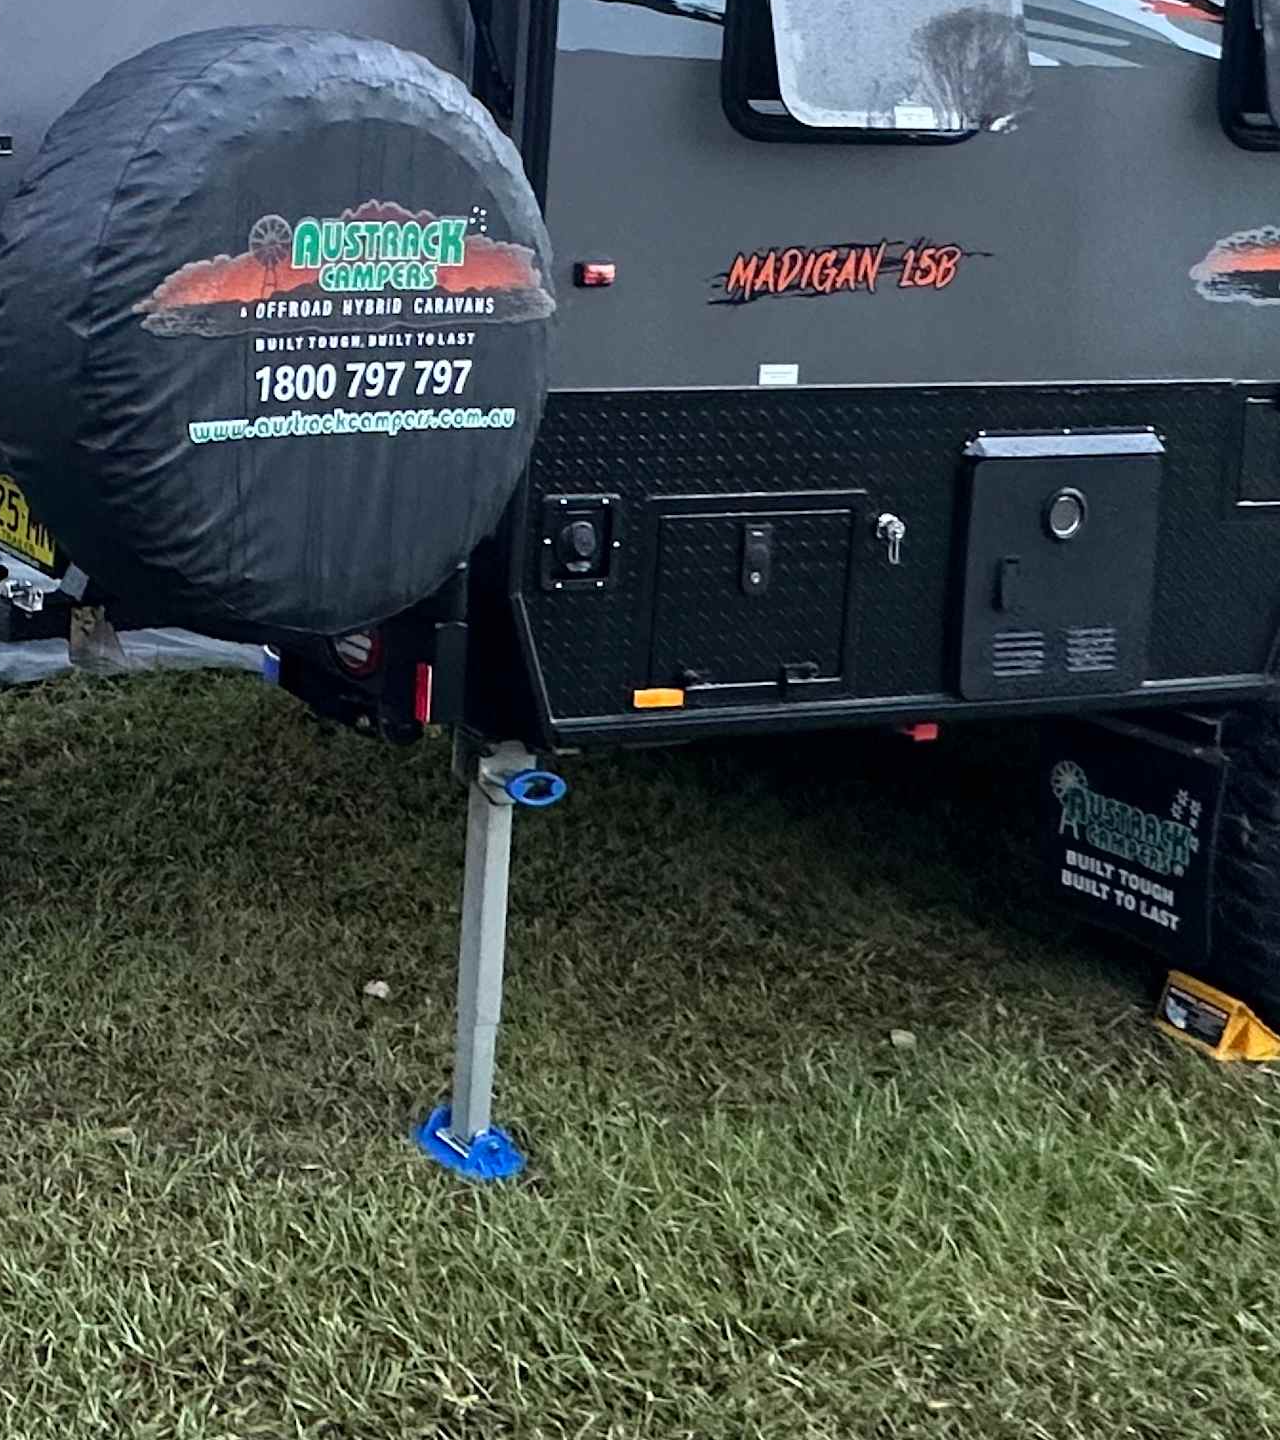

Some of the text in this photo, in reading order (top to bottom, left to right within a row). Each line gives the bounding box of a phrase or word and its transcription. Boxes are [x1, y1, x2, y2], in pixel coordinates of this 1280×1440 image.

[291, 217, 468, 269] AUSTRACK
[319, 261, 438, 292] CAMPERS
[727, 241, 963, 300] MADIGAN 15B
[255, 299, 333, 320] OFFROAD
[342, 297, 403, 317] HYBRID
[414, 296, 495, 315] CARAVANS
[255, 336, 304, 353] BUILT
[368, 333, 412, 348] BUILT
[417, 333, 434, 347] TO
[438, 331, 476, 346] LAST
[255, 359, 473, 402] 1800 797 797
[188, 407, 516, 444] www.austrackcampers.com.au
[1063, 784, 1191, 866] AUSTRACK
[1061, 868, 1181, 932] BUILT TO LAST
[1065, 849, 1174, 907] BUILT TOUGH
